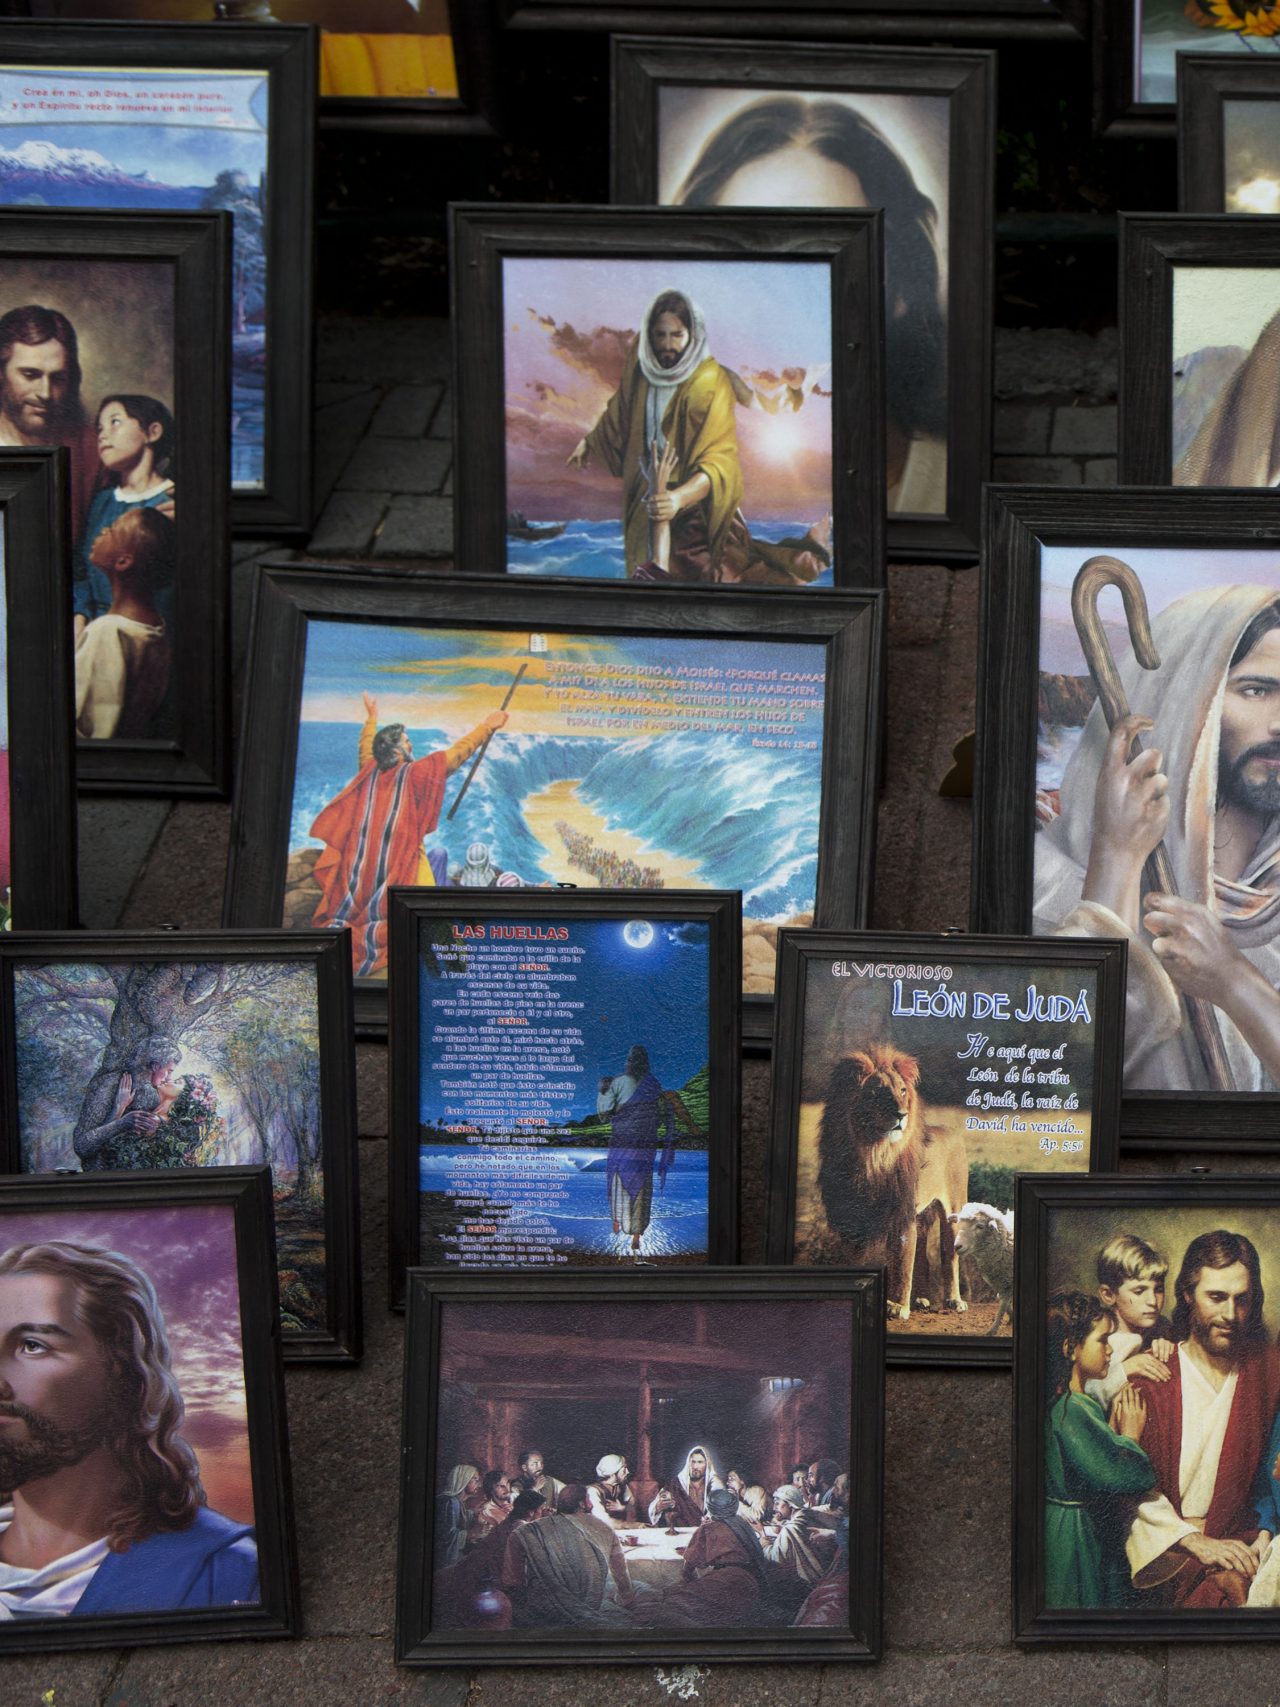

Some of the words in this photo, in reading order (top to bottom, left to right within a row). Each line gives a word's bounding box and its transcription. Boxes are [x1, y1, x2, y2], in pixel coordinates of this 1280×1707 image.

[452, 925, 485, 939] LAS
[490, 926, 569, 940] HUELLAS
[518, 963, 550, 971] SEÑOR.
[832, 961, 850, 978] EL
[852, 962, 953, 981] VICTORIOSO
[892, 980, 966, 1018] LEÓN
[972, 992, 1010, 1020] DE
[1014, 985, 1091, 1024] JUDÁ
[996, 1044, 1026, 1064] aquí
[1027, 1047, 1050, 1065] que
[1052, 1043, 1067, 1060] el
[967, 1067, 999, 1082] León
[1004, 1067, 1019, 1083] de
[1021, 1067, 1035, 1084] la
[1037, 1070, 1070, 1085] tribu
[966, 1091, 981, 1107] de
[981, 1092, 1019, 1110] Judá,
[1020, 1091, 1034, 1108] la
[1036, 1093, 1063, 1109] raíz
[1064, 1092, 1079, 1110] de
[965, 1116, 1008, 1133] David,
[1011, 1119, 1027, 1132] ha
[1031, 1120, 1084, 1135] vencido...
[1039, 1137, 1059, 1156] Ap.
